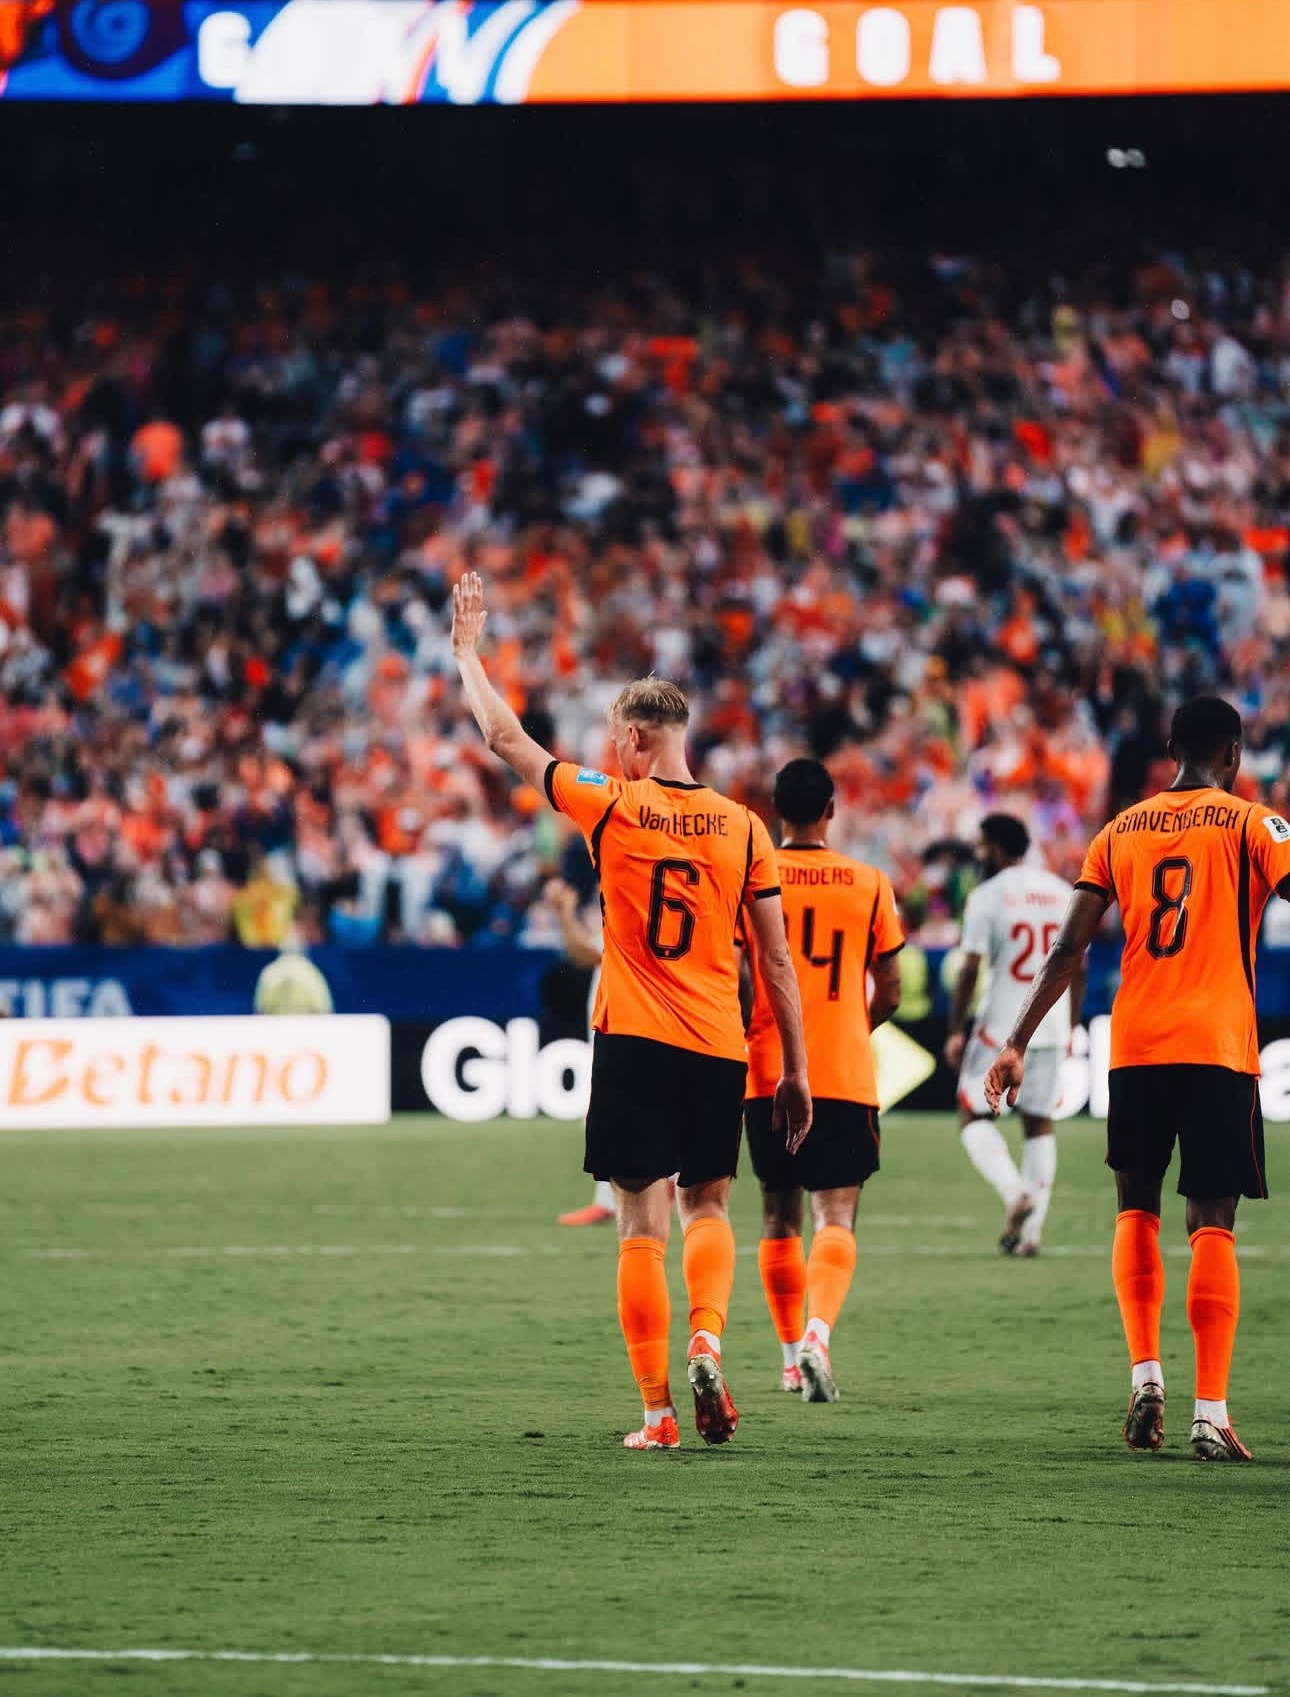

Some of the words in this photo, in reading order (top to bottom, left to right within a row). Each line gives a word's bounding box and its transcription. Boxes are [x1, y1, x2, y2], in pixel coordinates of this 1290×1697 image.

[774, 5, 1061, 86] GOAL
[1116, 805, 1240, 834] GRAVENBERCH
[647, 857, 700, 961] 6
[783, 906, 844, 1001] 4
[1146, 856, 1193, 960] 8
